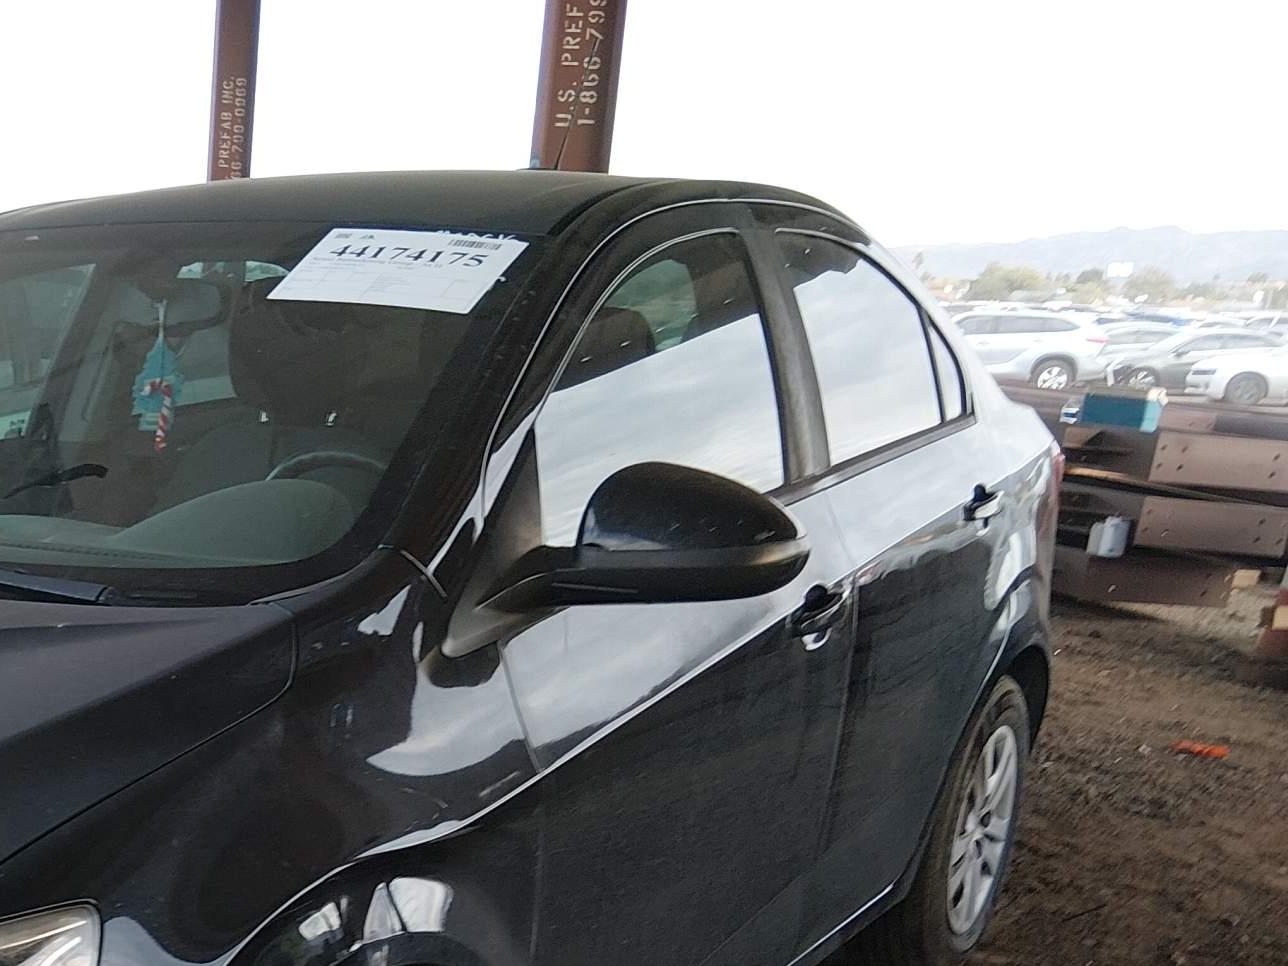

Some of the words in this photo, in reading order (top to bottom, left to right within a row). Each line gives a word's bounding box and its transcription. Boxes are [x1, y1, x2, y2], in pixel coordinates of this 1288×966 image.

[560, 3, 584, 66] PREF
[221, 76, 235, 104] INC.
[553, 82, 577, 127] U.S.
[217, 112, 233, 168] PREFAB
[330, 244, 488, 268] 44174175
